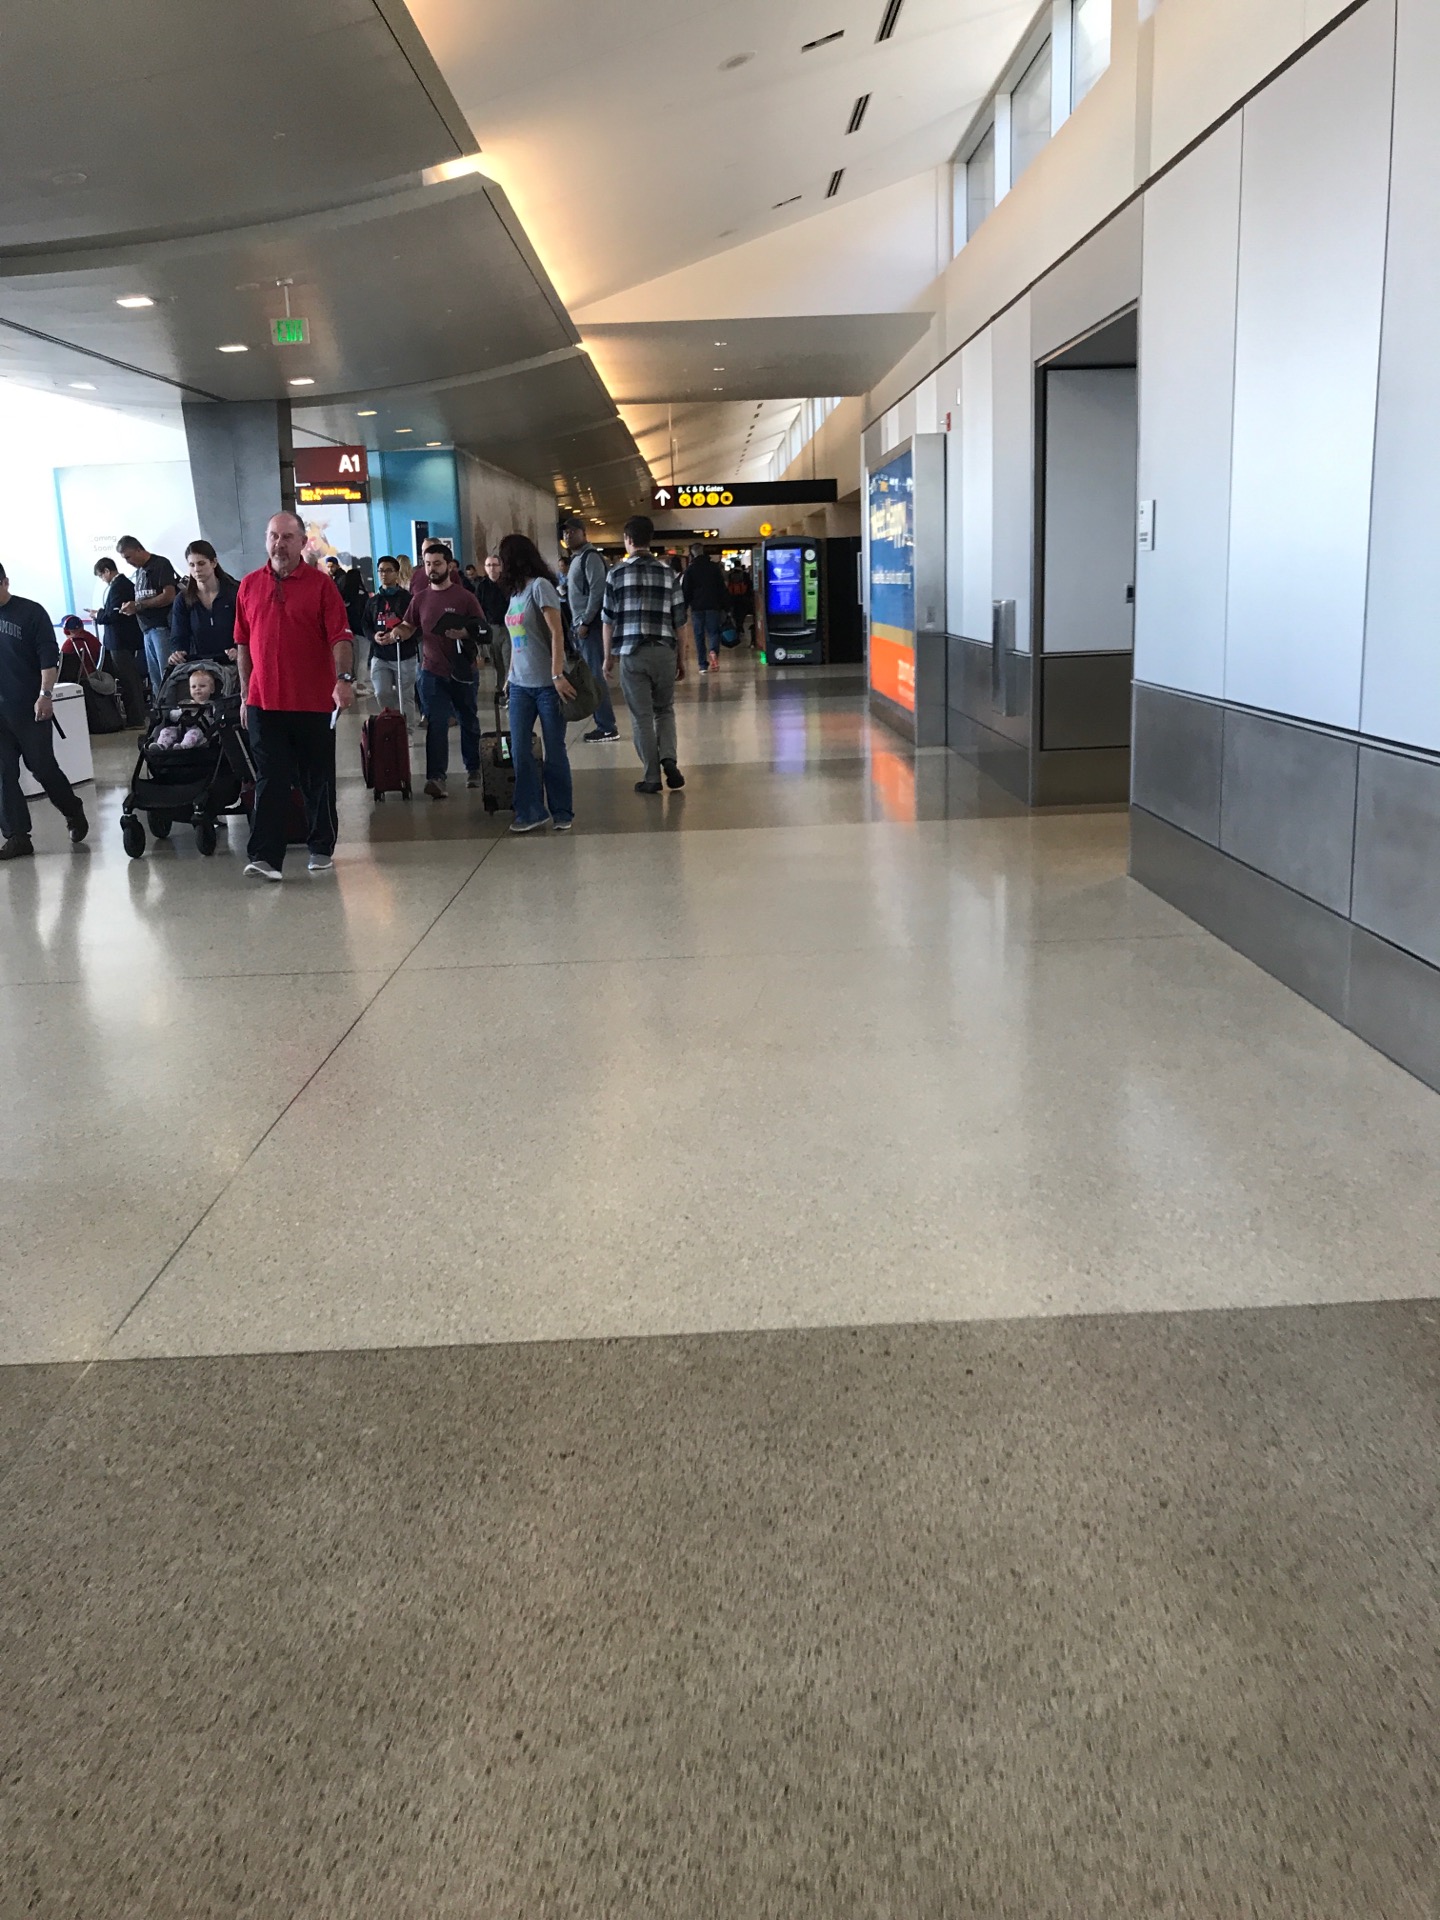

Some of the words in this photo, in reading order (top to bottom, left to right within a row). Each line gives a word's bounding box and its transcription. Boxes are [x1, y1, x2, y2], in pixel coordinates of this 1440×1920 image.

[339, 454, 361, 473] A1
[692, 485, 698, 493] &
[698, 485, 705, 493] D
[705, 485, 724, 493] Gates
